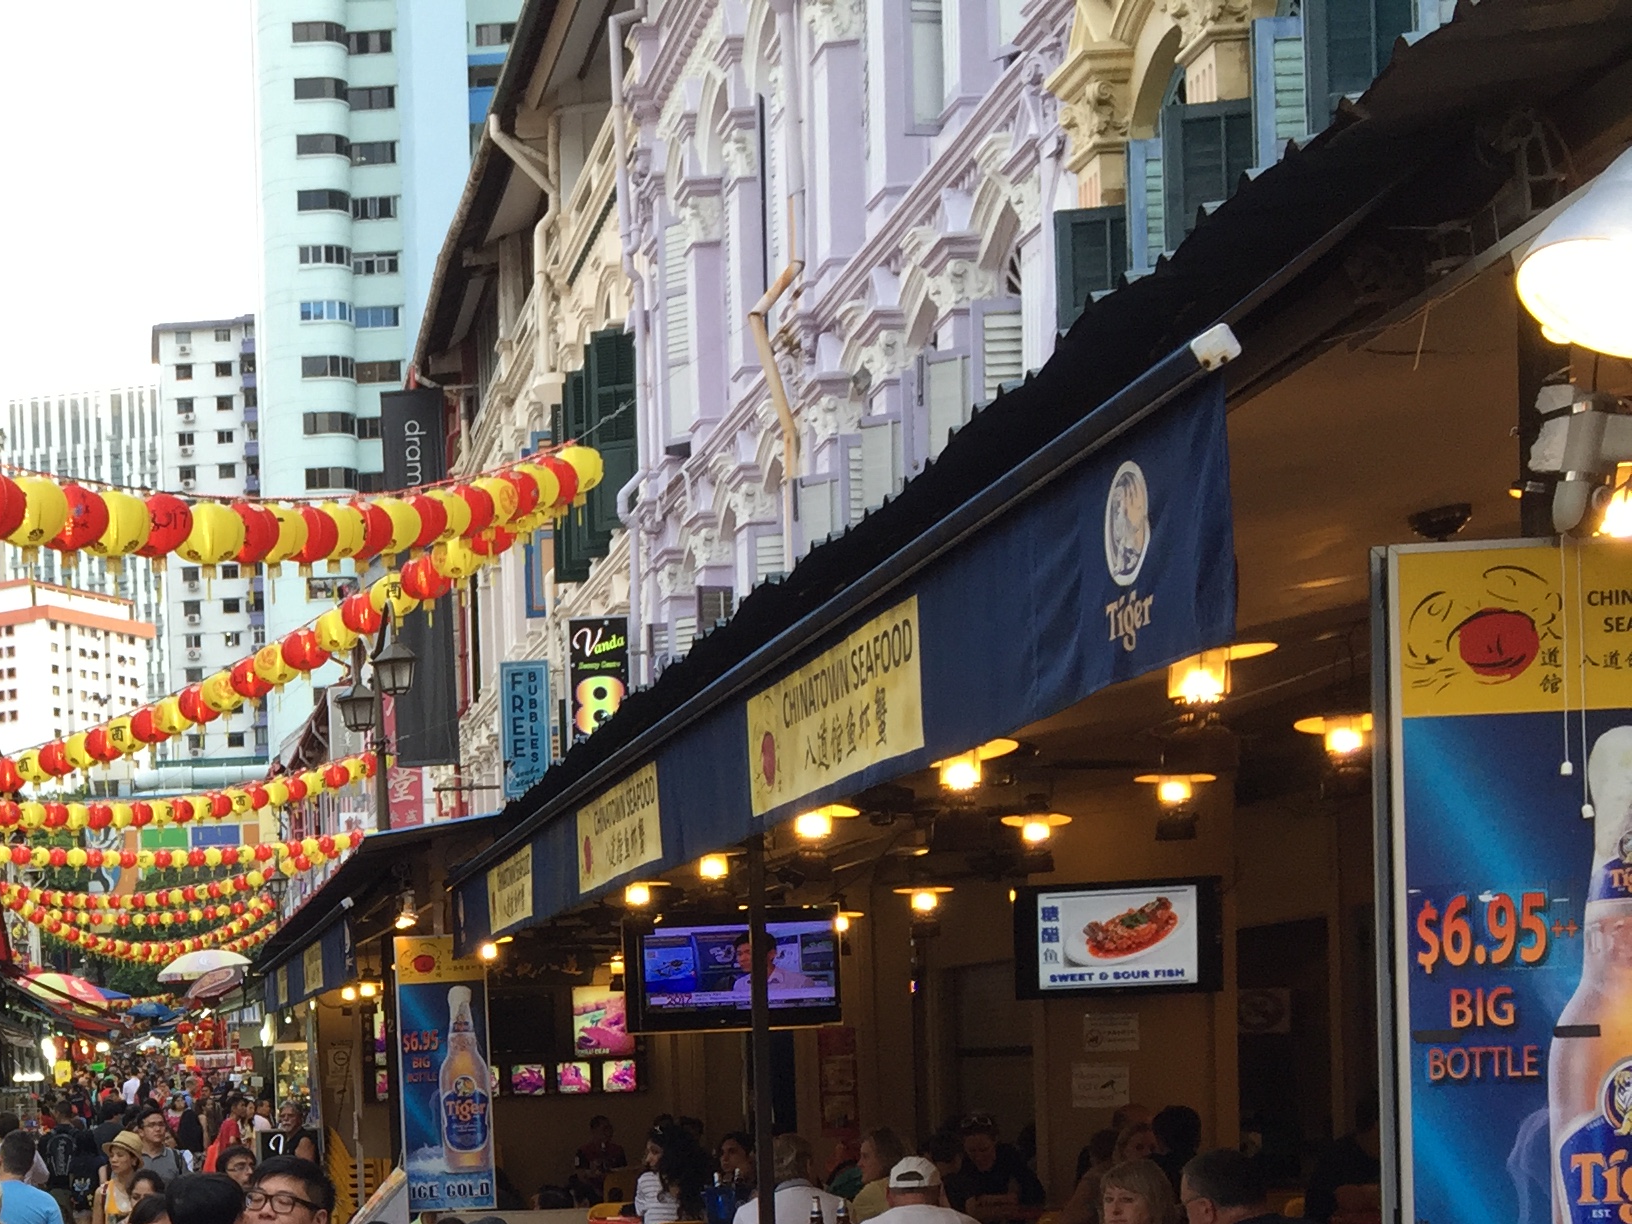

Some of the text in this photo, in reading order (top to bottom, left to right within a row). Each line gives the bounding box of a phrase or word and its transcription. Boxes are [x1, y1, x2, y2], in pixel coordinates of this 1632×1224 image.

[404, 420, 427, 486] dram
[573, 627, 625, 657] Vanda
[1106, 589, 1154, 652] Tiger
[783, 618, 913, 729] CHINATOWN SEAFOOD
[511, 672, 525, 758] FREE
[528, 672, 539, 763] BUBBLES
[576, 675, 626, 735] 8
[1050, 968, 1185, 983] SWEET & SOUR FISH
[1450, 986, 1515, 1028] BIG
[1428, 1045, 1539, 1080] BOTTLE
[446, 1099, 486, 1121] Tiger
